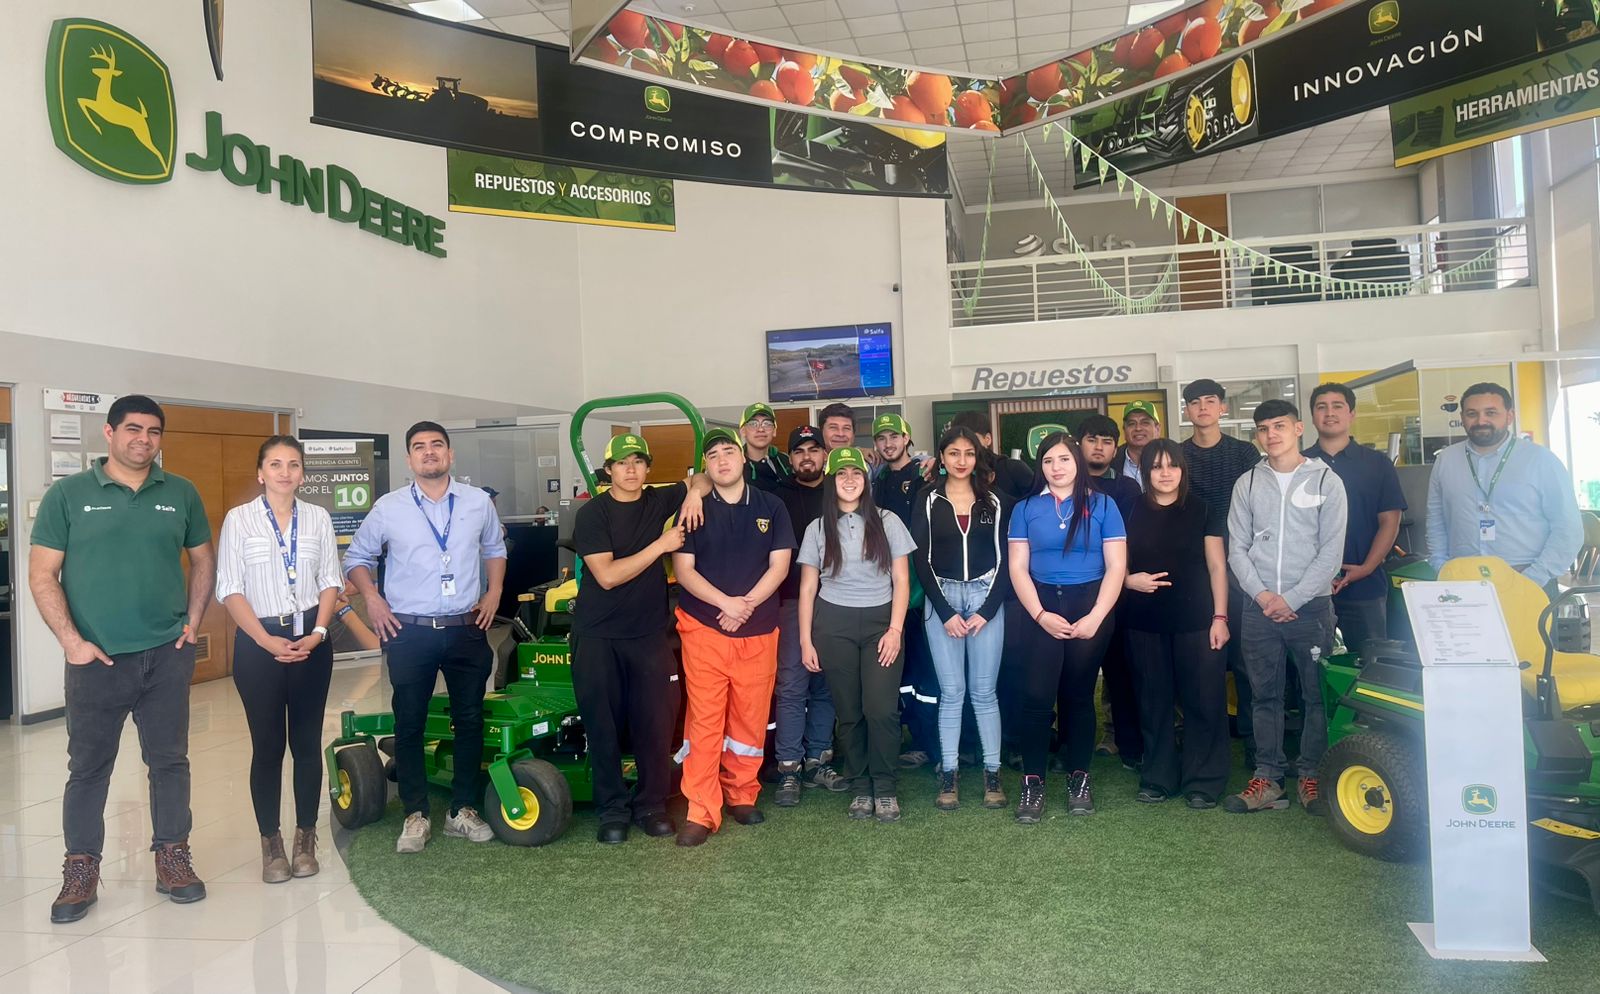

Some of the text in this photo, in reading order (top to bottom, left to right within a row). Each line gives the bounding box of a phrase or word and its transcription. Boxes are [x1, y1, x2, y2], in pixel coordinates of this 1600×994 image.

[1293, 25, 1483, 101] INNOVACIÓN
[1456, 68, 1600, 123] HERRAMIENTAS
[570, 121, 742, 158] COMPROMISO
[185, 111, 447, 258] JOHN DEERE
[474, 173, 652, 206] REPUESTOS Y ACCESORIOS
[971, 363, 1132, 391] Repuestos
[299, 485, 332, 494] POR EL
[304, 473, 369, 483] MOS JUNTOS
[337, 486, 368, 507] 10
[532, 652, 564, 664] JOHN
[1445, 818, 1517, 829] JOHN DEERE
